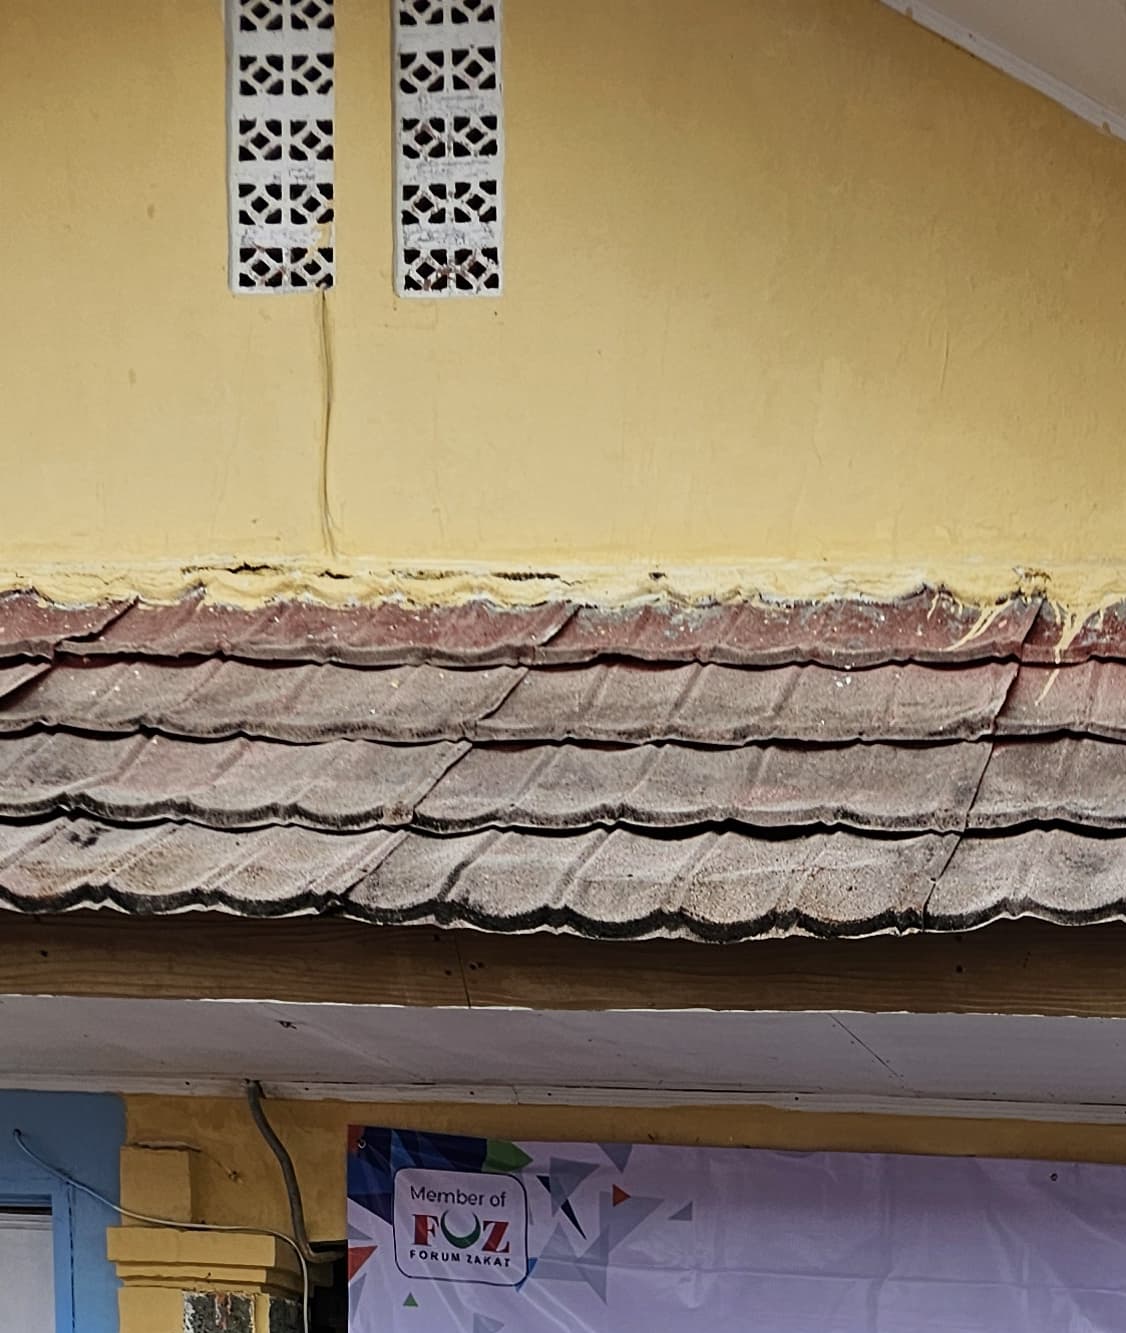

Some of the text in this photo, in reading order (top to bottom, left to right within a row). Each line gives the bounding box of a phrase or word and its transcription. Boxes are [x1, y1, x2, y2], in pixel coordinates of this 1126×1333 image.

[410, 1185, 506, 1207] Member of
[410, 1250, 511, 1267] FORUM ZAKAT
